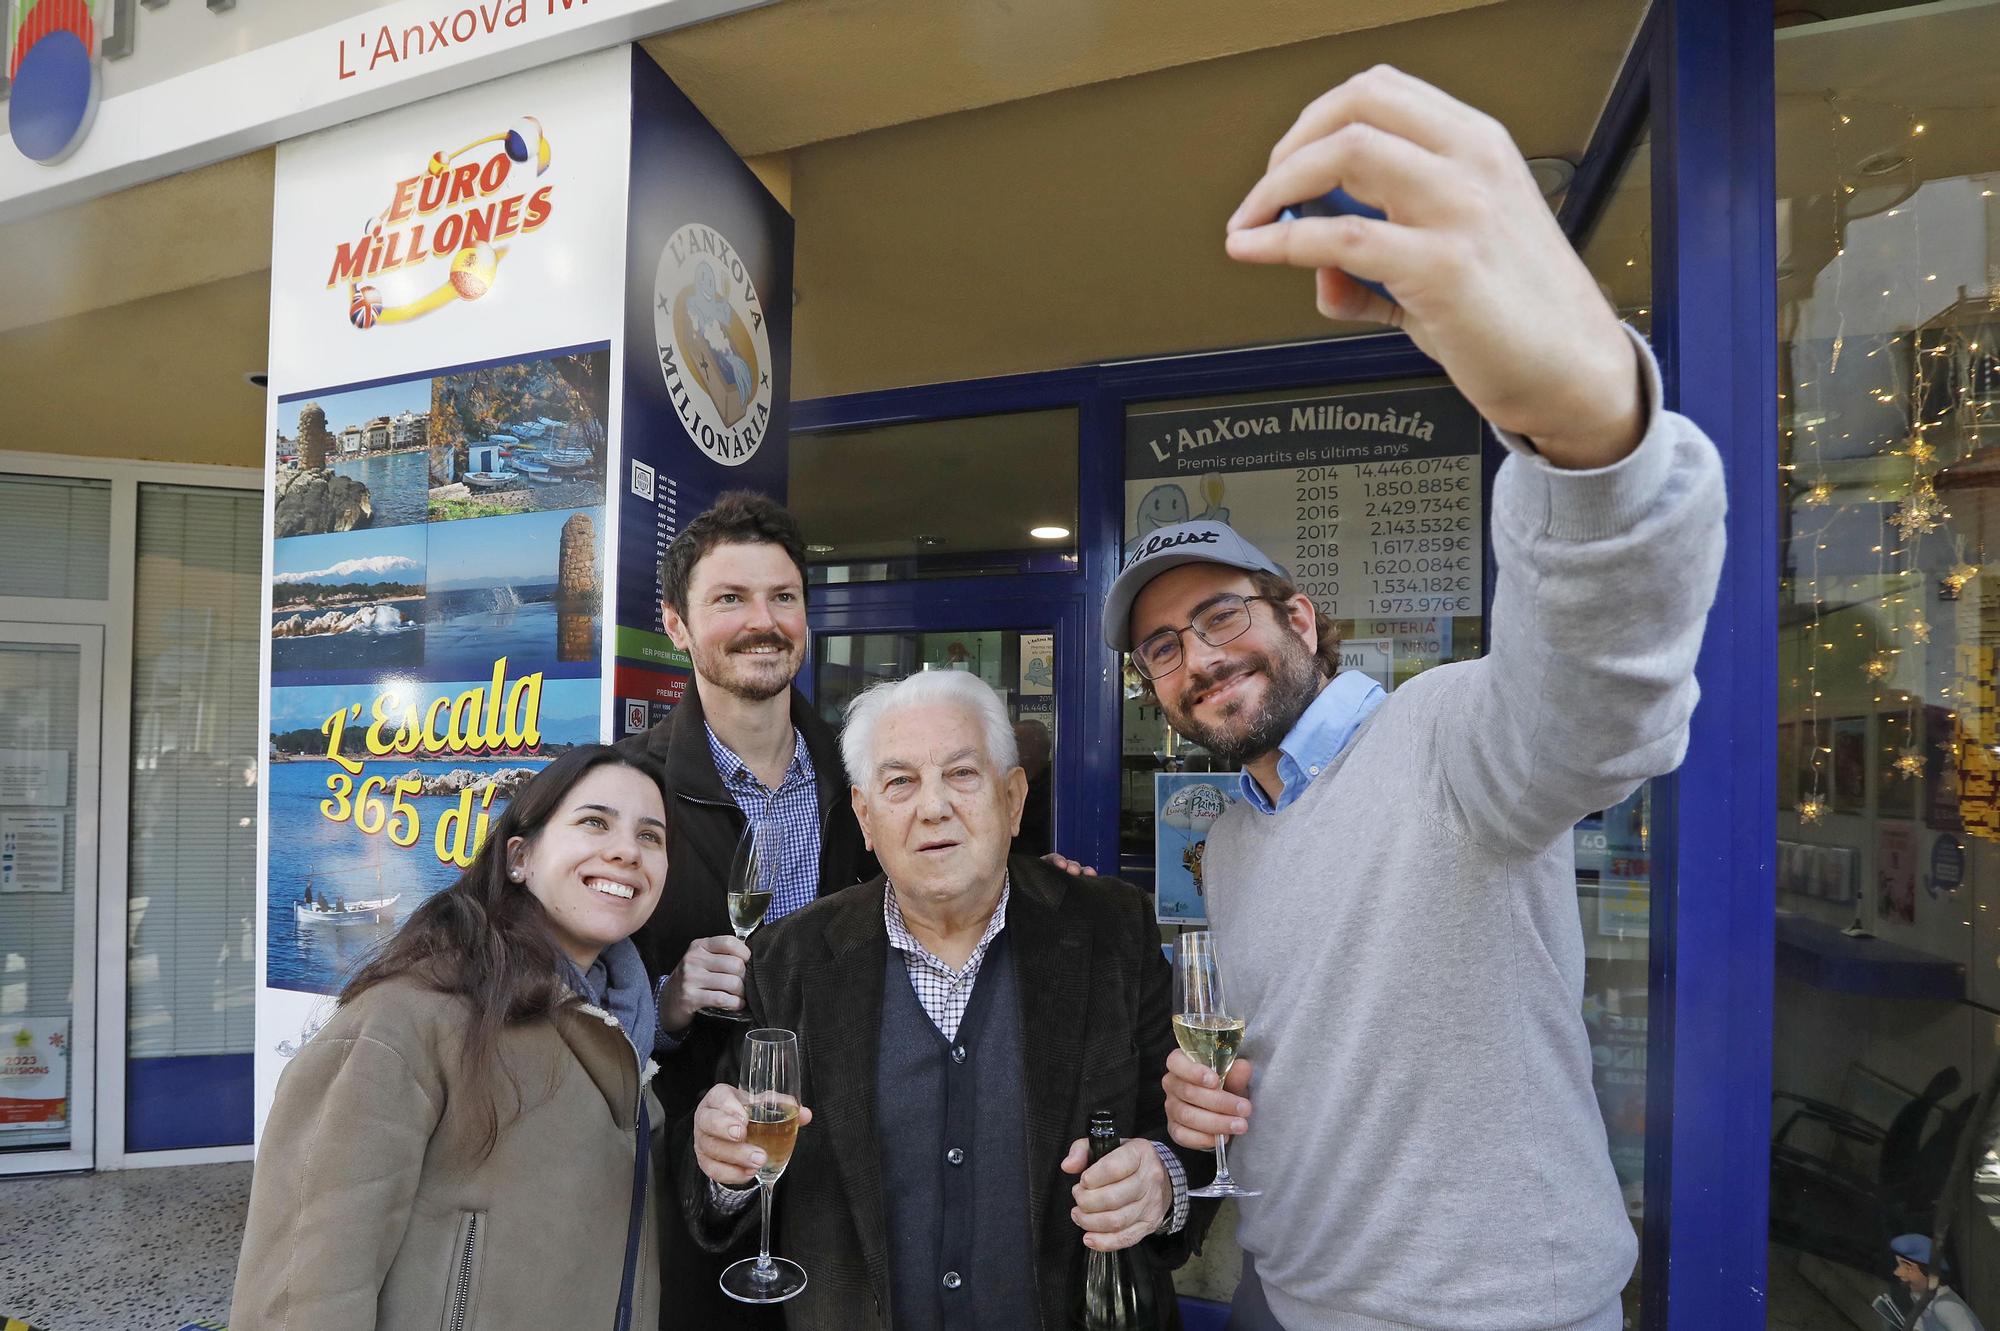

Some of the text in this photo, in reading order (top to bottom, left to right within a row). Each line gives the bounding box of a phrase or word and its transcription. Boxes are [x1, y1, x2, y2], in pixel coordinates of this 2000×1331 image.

[339, 0, 527, 80] L'Anxova
[387, 153, 511, 225] EURO
[669, 228, 762, 334] L'ANXOVA
[659, 344, 768, 458] MILIONÀRIA
[1149, 405, 1435, 463] L'AnXova Milionària
[1177, 442, 1409, 470] Premis repartits els últims anys
[1296, 457, 1470, 483] 2014 14.446.074€
[1296, 477, 1470, 501] 2015 1.850.885€
[1296, 497, 1470, 520] 2016 2.429.734€
[1296, 517, 1470, 540] 2017 2.143.532€
[1296, 536, 1470, 559] 2018 1.617.859€
[1296, 556, 1470, 578] 2019 1.620.084€
[1296, 576, 1470, 597] 2020 1.534.182€
[1314, 596, 1470, 615] 21 1.973.976€
[321, 656, 543, 775] L'Escala
[320, 773, 496, 869] 365 dí
